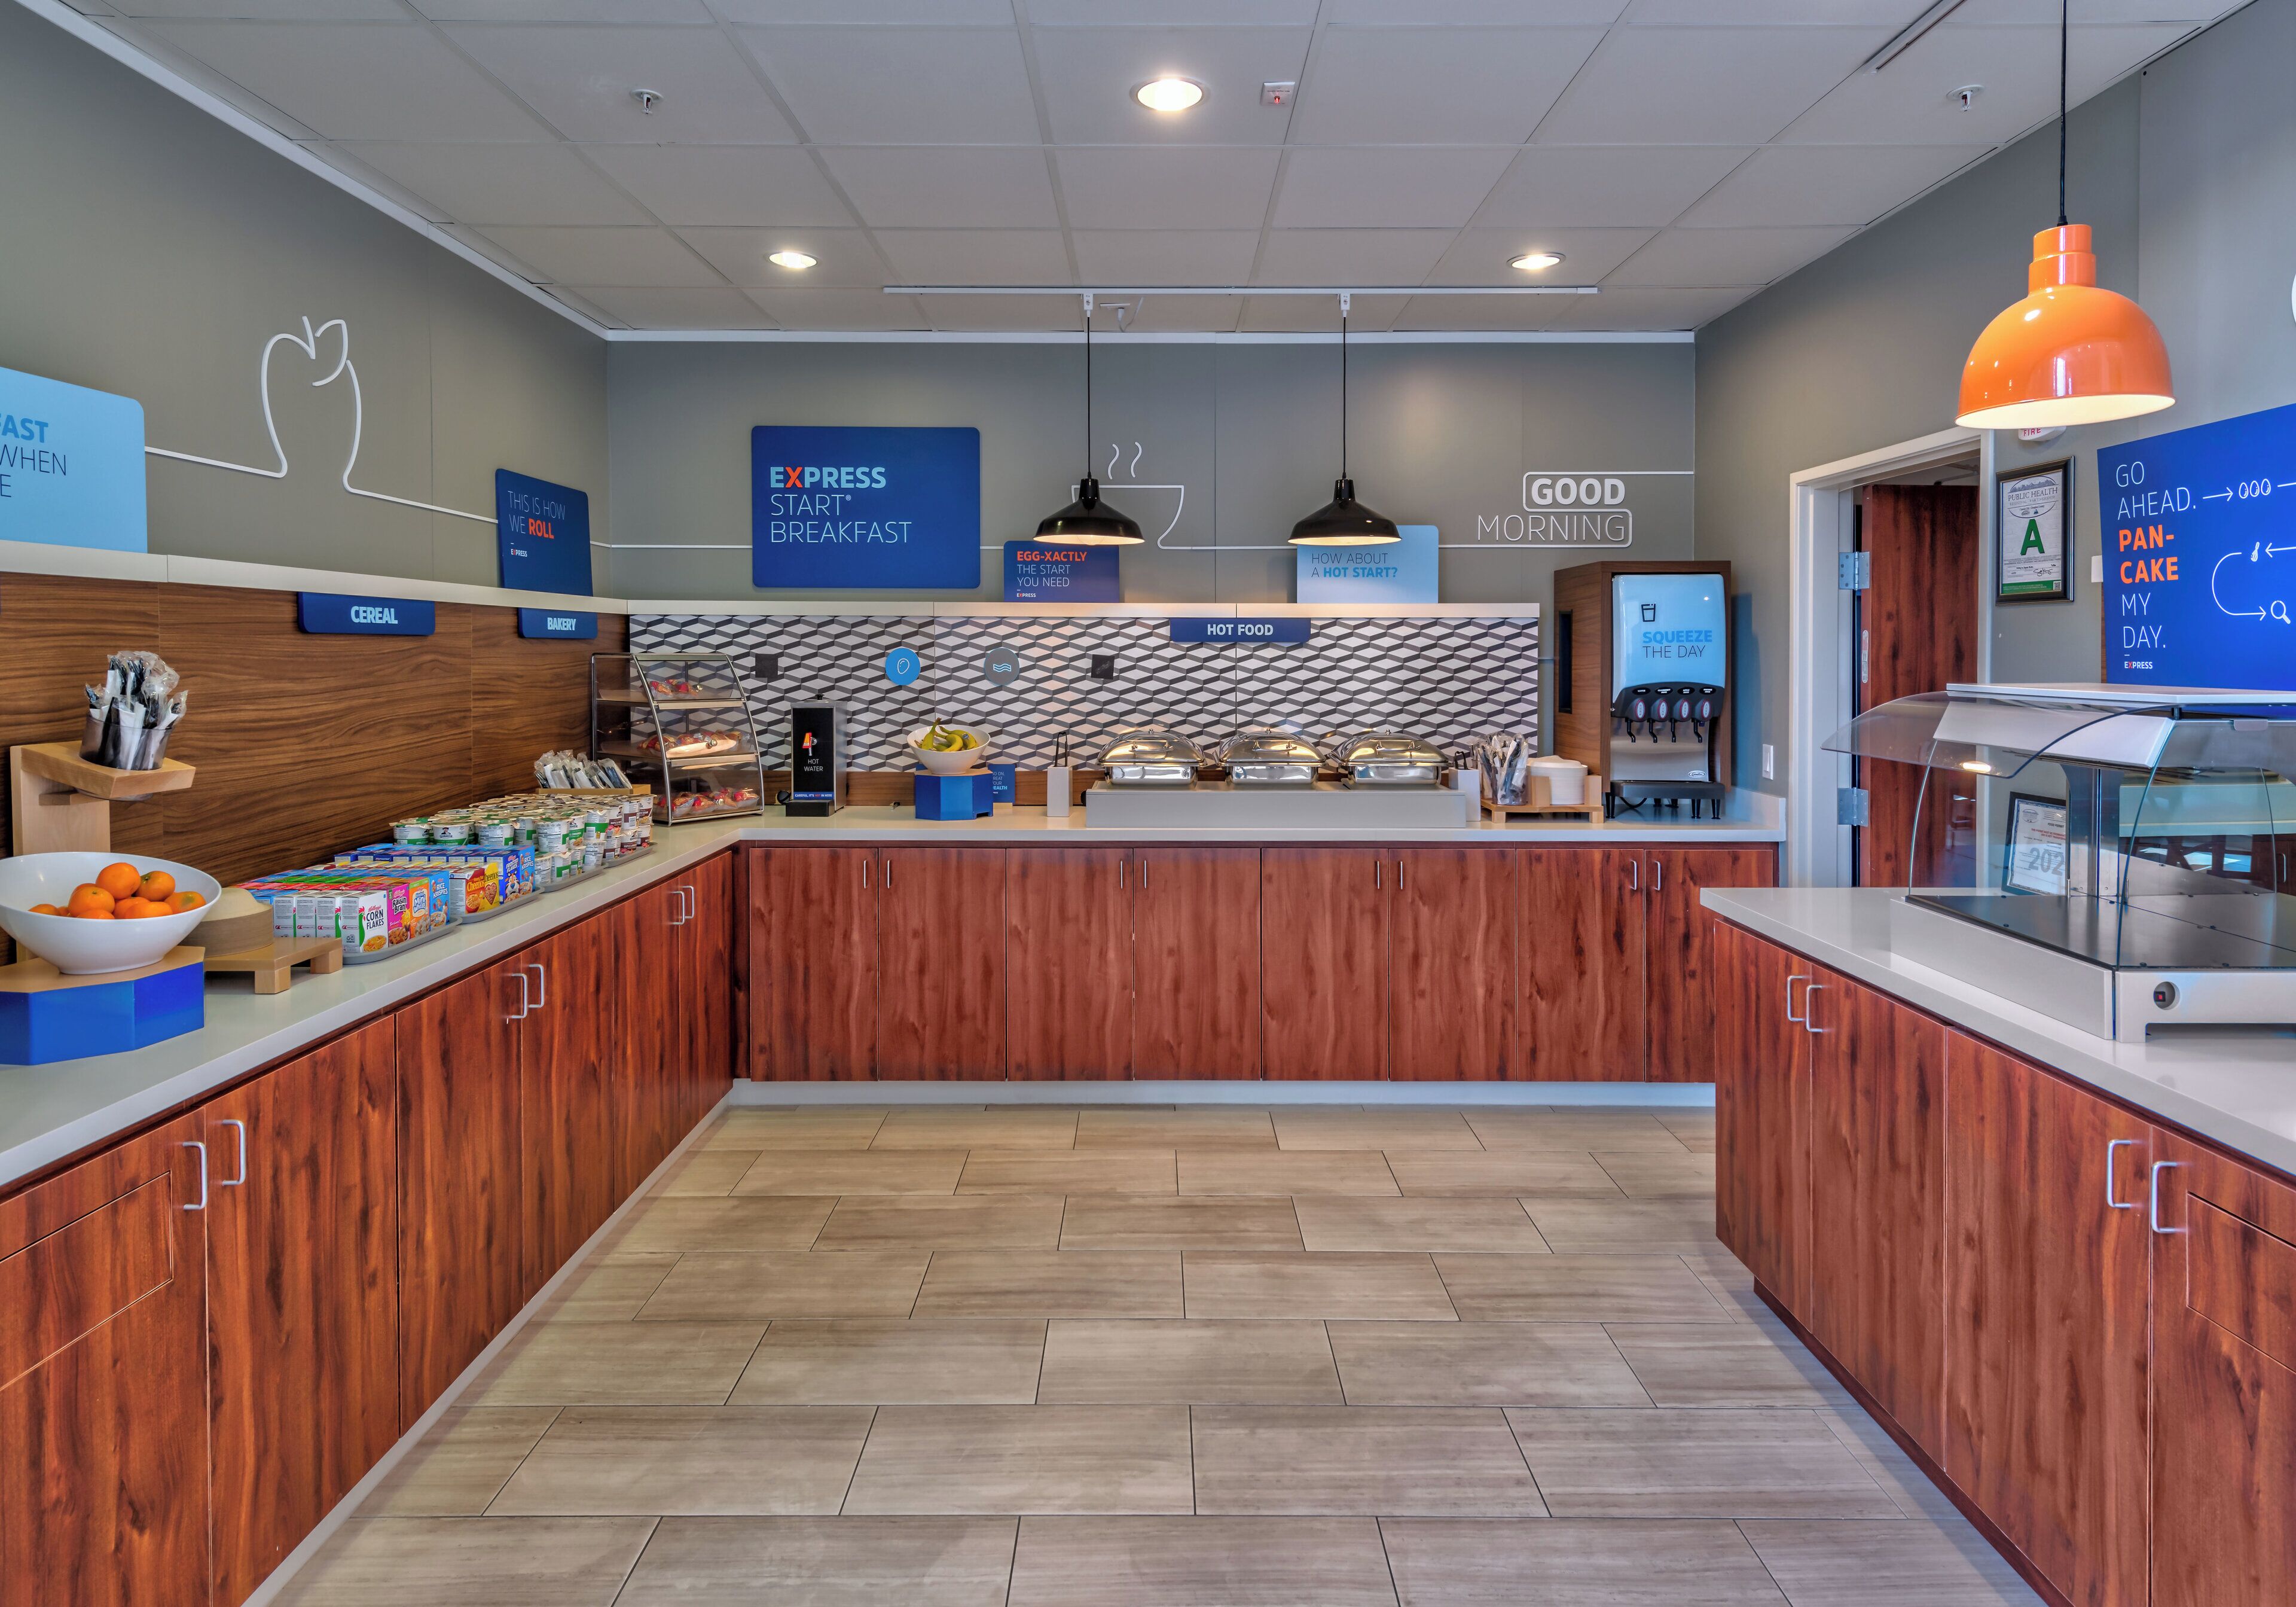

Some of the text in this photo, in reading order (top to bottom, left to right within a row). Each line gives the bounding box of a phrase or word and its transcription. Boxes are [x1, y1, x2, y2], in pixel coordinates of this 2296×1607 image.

[0, 413, 49, 443] AST
[2023, 427, 2042, 437] FIRE
[0, 444, 66, 476] WHEN
[770, 466, 887, 489] EXPRESS
[2116, 461, 2145, 487] GO
[1531, 478, 1626, 505] GOOD
[2008, 487, 2058, 502] PUBLIC HEALTH
[508, 490, 566, 520] THIS IS HOW
[2117, 487, 2196, 520] AHEAD.
[509, 514, 554, 539] WE ROLL
[771, 522, 912, 543] BREAKFAST
[1477, 515, 1625, 541] MORNING
[2020, 519, 2045, 556] A
[2119, 524, 2175, 552] PAN-
[511, 548, 527, 557] EXPRESS
[1017, 551, 1088, 562] EGG-XACTLY
[1312, 553, 1388, 564] HOW ABOUT
[1017, 565, 1071, 574] THE START
[1311, 567, 1398, 578] A HOT START?
[2120, 556, 2179, 584] CAKE
[1017, 577, 1070, 587] YOU NEED
[2122, 592, 2151, 617] MY
[350, 606, 398, 624] CEREAL
[547, 617, 576, 630] BAKERY
[1207, 624, 1274, 635] HOT FOOD
[1642, 630, 1712, 645] SQUEEZE
[2123, 625, 2166, 649] DAY.
[1642, 645, 1706, 658] THE DAY
[2124, 661, 2153, 670] EXPRESS
[484, 872, 499, 882] heerios
[433, 888, 448, 898] KRISPIES
[436, 882, 445, 891] RICE
[392, 897, 407, 908] Raisin
[414, 895, 426, 906] Mini
[366, 909, 383, 922] CORN
[393, 904, 407, 915] Bran
[367, 919, 384, 930] FLAKES
